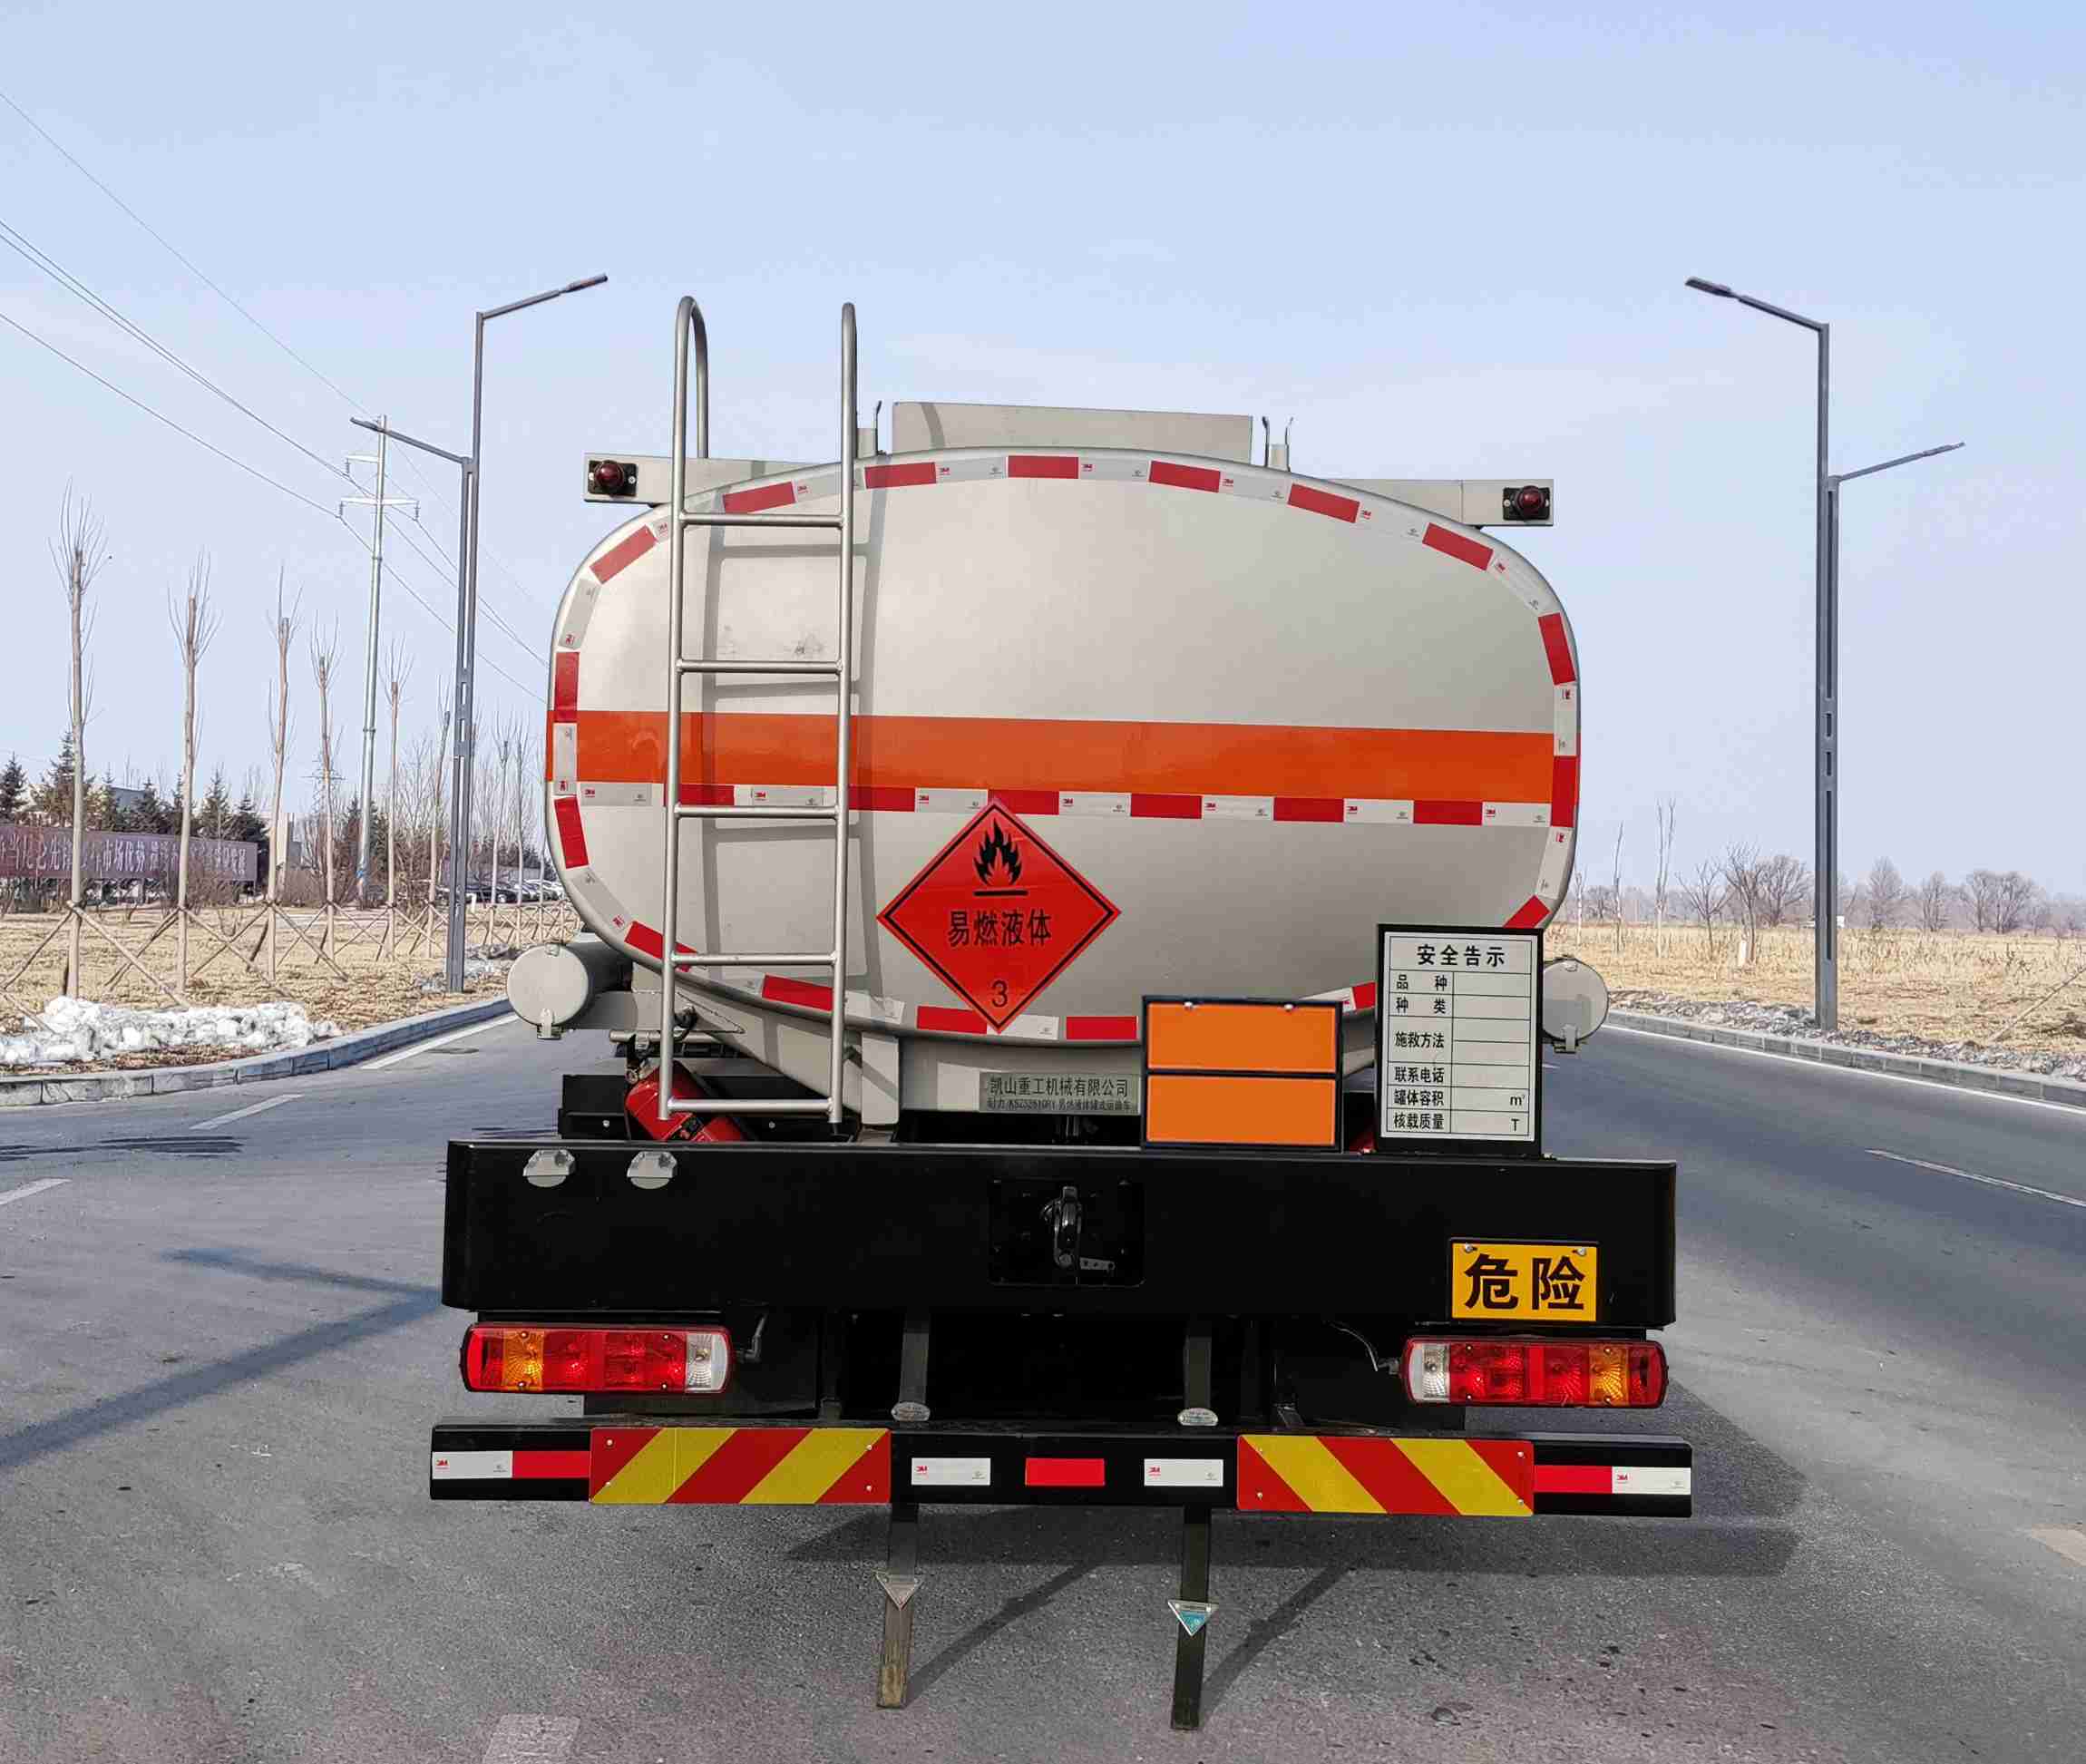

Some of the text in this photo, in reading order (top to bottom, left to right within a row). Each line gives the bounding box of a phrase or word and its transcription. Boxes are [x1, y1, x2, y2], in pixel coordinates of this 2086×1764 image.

[948, 911, 1051, 947] 易燃液体
[1417, 944, 1506, 968] 安全告示
[1396, 974, 1448, 990] 品 种
[991, 980, 1008, 1008] 3
[1396, 997, 1446, 1015] 种 类
[1395, 1031, 1445, 1049] 施救方法
[1394, 1067, 1445, 1084] 联系电话
[989, 1077, 1128, 1097] 凯山重工机械有限公司
[1394, 1089, 1444, 1106] 罐体容积
[1393, 1113, 1520, 1132] 核载质量 T
[1464, 1252, 1586, 1311] 危险
